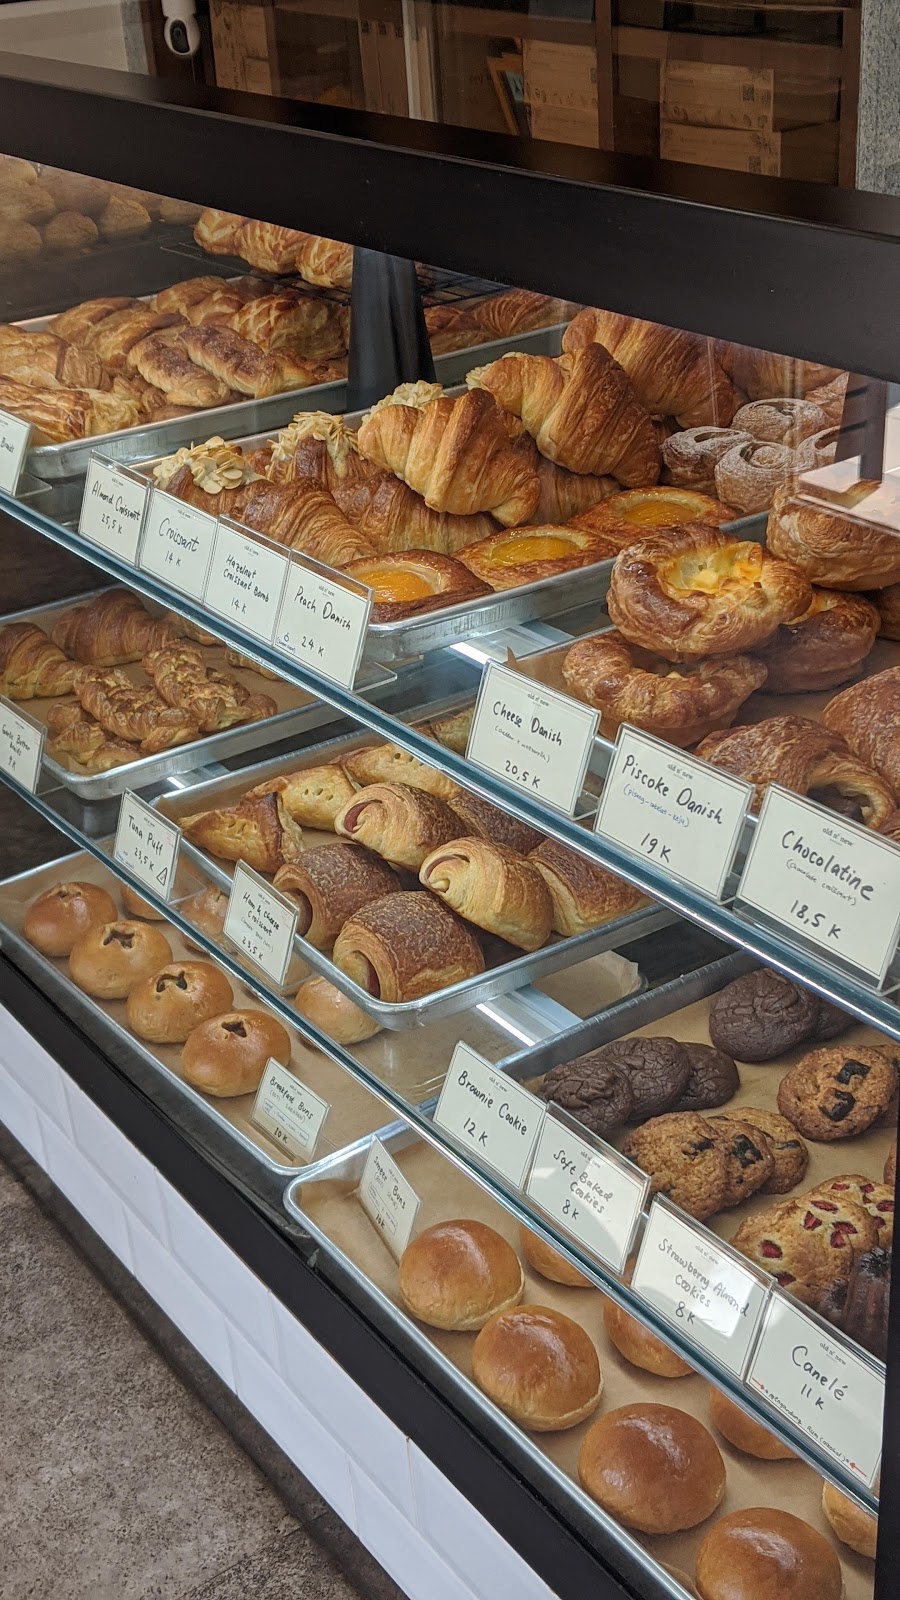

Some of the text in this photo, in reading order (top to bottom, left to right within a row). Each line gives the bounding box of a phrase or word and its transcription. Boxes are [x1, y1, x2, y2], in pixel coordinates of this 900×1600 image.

[92, 481, 140, 520] Almond Croissant
[101, 513, 117, 529] 25,5
[159, 517, 199, 552] Croissant
[165, 550, 173, 564] 14
[226, 554, 257, 579] Hazelnut
[223, 568, 270, 603] Croissant Bomb
[231, 597, 240, 610] 14
[294, 585, 351, 631] Peach Danish
[301, 636, 315, 650] 24
[317, 646, 325, 657] K
[493, 701, 563, 746] Cheese Danish
[505, 760, 541, 789] 20,5 K
[621, 754, 722, 825] Piscoke Danish
[128, 814, 143, 839] Tuna
[146, 832, 164, 856] Puff
[640, 833, 672, 863] 19 K
[822, 827, 833, 837] old
[840, 836, 853, 846] new
[134, 847, 149, 864] 23,5
[781, 830, 874, 901] Chocolatine
[242, 891, 255, 910] Ham
[247, 910, 273, 936] Croissant
[790, 900, 842, 939] 18,5 K
[242, 936, 258, 955] 23,5
[269, 1076, 295, 1104] Breakfast
[297, 1101, 314, 1120] Buns
[458, 1070, 528, 1136] Brownie Cookie
[274, 1127, 282, 1138] 10
[463, 1117, 489, 1147] 12 K
[553, 1150, 614, 1203] Soft Baked
[392, 1185, 406, 1209] Buns
[562, 1199, 571, 1215] 8
[569, 1181, 605, 1214] Cookies
[658, 1238, 750, 1317] Strawberry Almond
[675, 1274, 712, 1308] Cookies
[675, 1300, 685, 1318] 8
[819, 1342, 829, 1352] old
[835, 1354, 846, 1365] new
[791, 1345, 849, 1401] Canelé
[800, 1384, 812, 1398] 11
